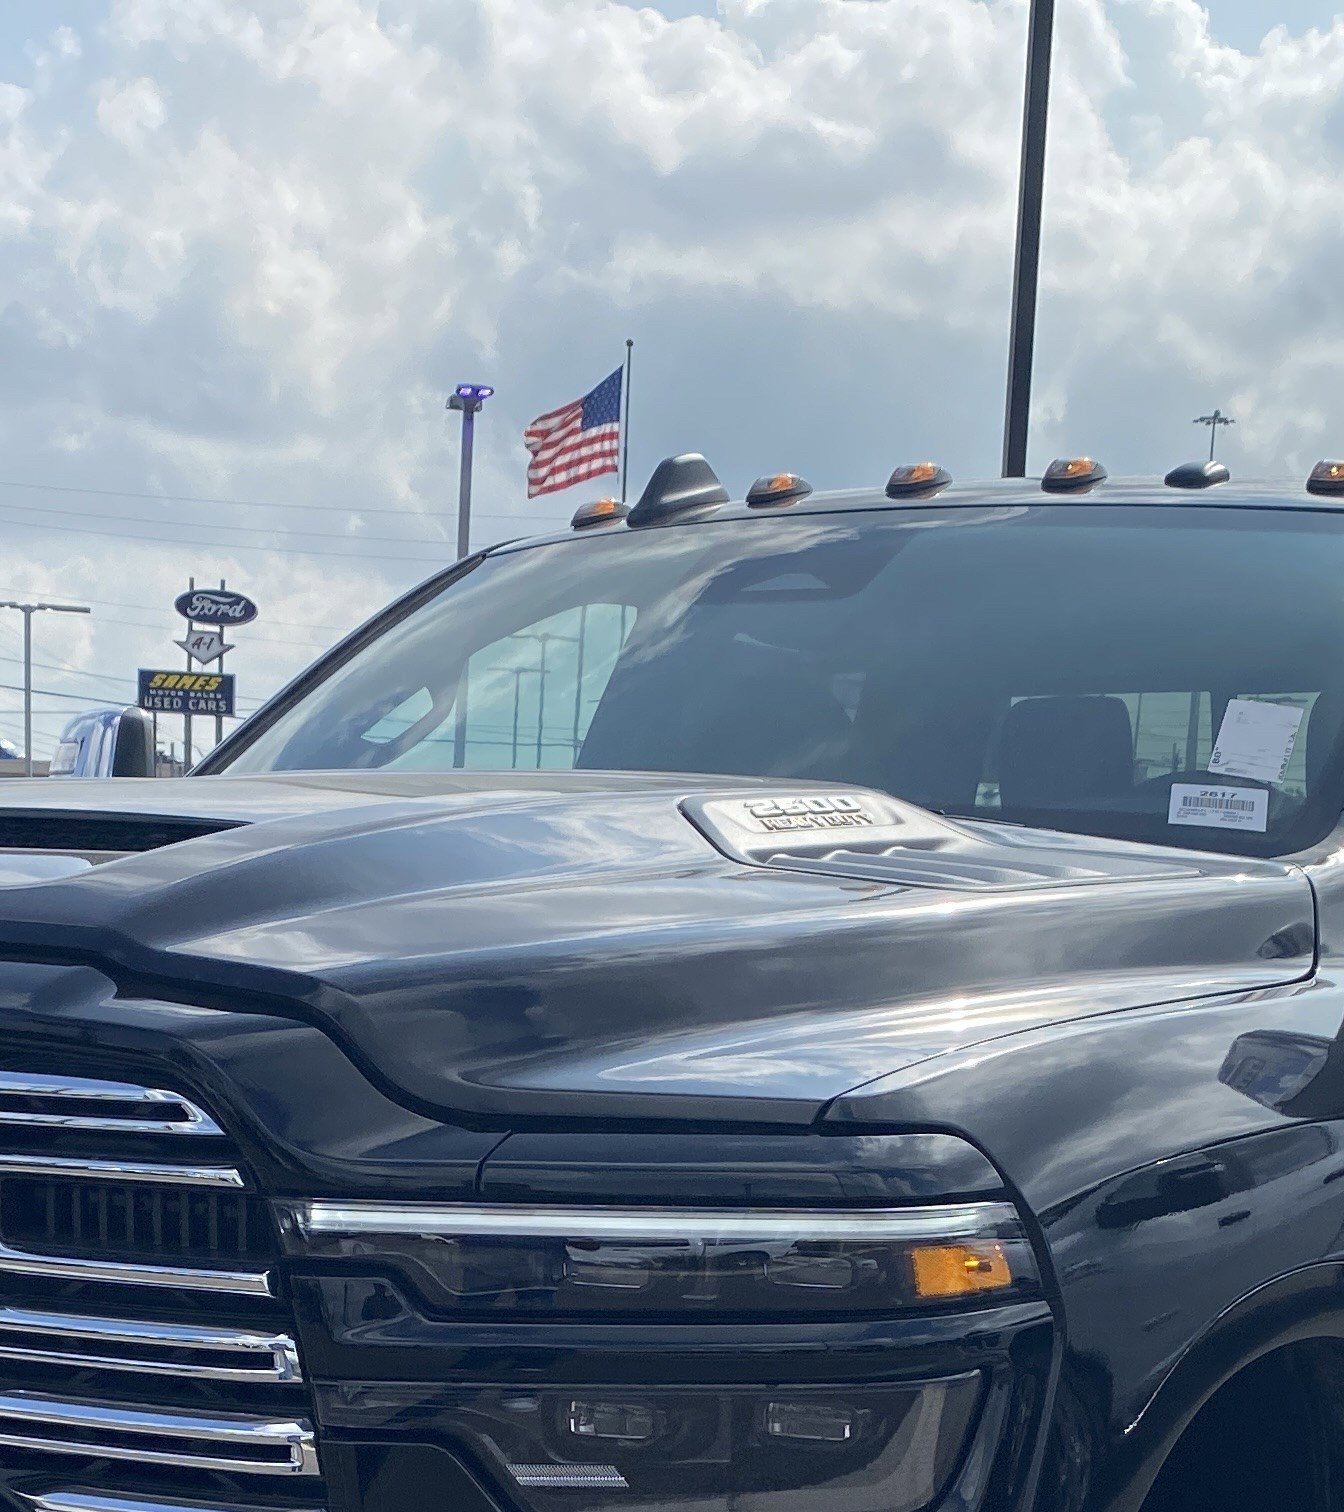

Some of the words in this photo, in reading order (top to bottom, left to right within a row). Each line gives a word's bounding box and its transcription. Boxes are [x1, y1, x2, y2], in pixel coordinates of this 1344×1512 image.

[186, 593, 246, 617] Ford
[191, 636, 214, 651] A-1
[149, 673, 222, 691] SAMES
[189, 691, 222, 699] SALES
[144, 696, 183, 709] USED
[188, 699, 227, 712] CARS
[744, 796, 862, 818] 2500
[760, 816, 825, 830] HEAVY
[822, 813, 874, 827] DUTY
